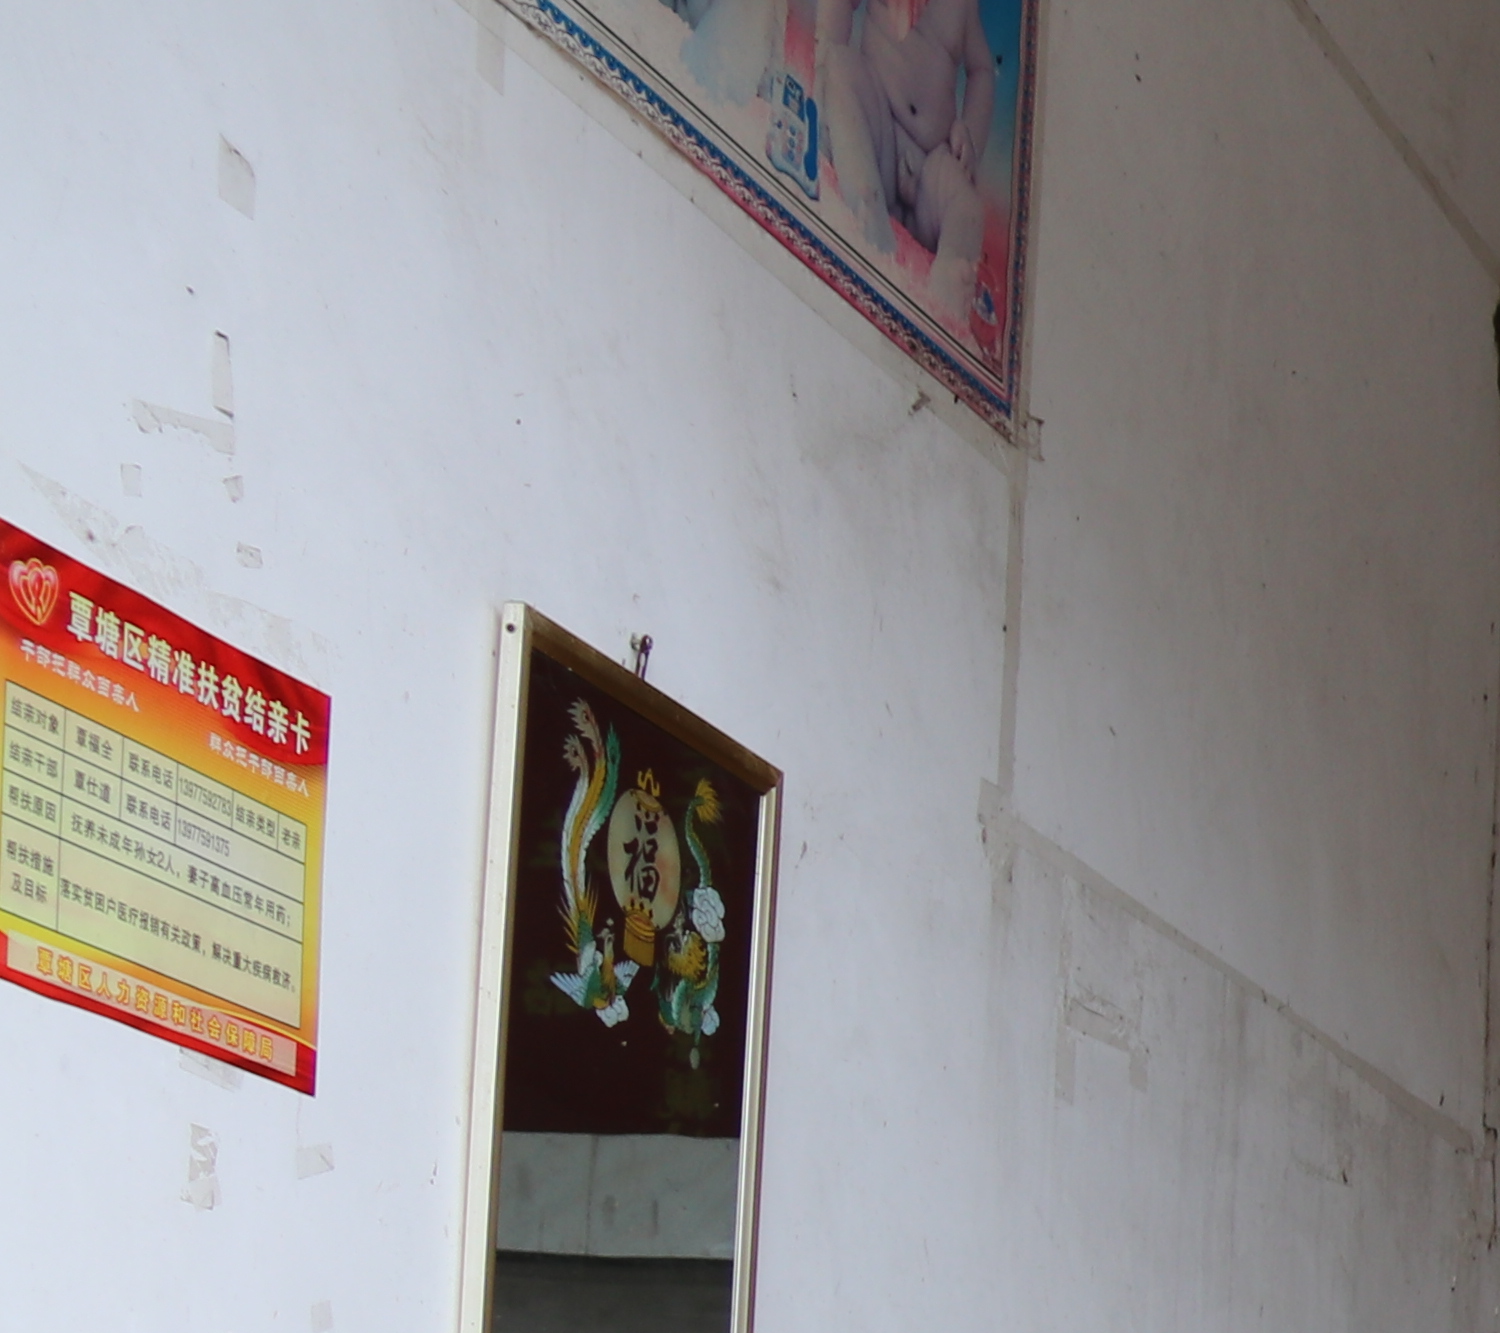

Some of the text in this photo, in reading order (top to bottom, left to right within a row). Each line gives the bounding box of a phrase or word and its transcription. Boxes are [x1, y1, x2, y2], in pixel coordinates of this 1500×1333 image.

[66, 590, 311, 756] 覃塘区精准扶贫结亲卡
[7, 784, 58, 825] 帮扶原因
[8, 740, 59, 781] 结亲干部
[125, 793, 173, 833] 联系电话
[10, 697, 60, 738] 结亲对象
[128, 750, 175, 791] 联系电话
[235, 803, 276, 838] 结亲类型
[5, 838, 55, 879] 帮扶措施
[11, 871, 48, 905] 及目标
[36, 946, 275, 1062] 覃塘区人力资源和社会保障局
